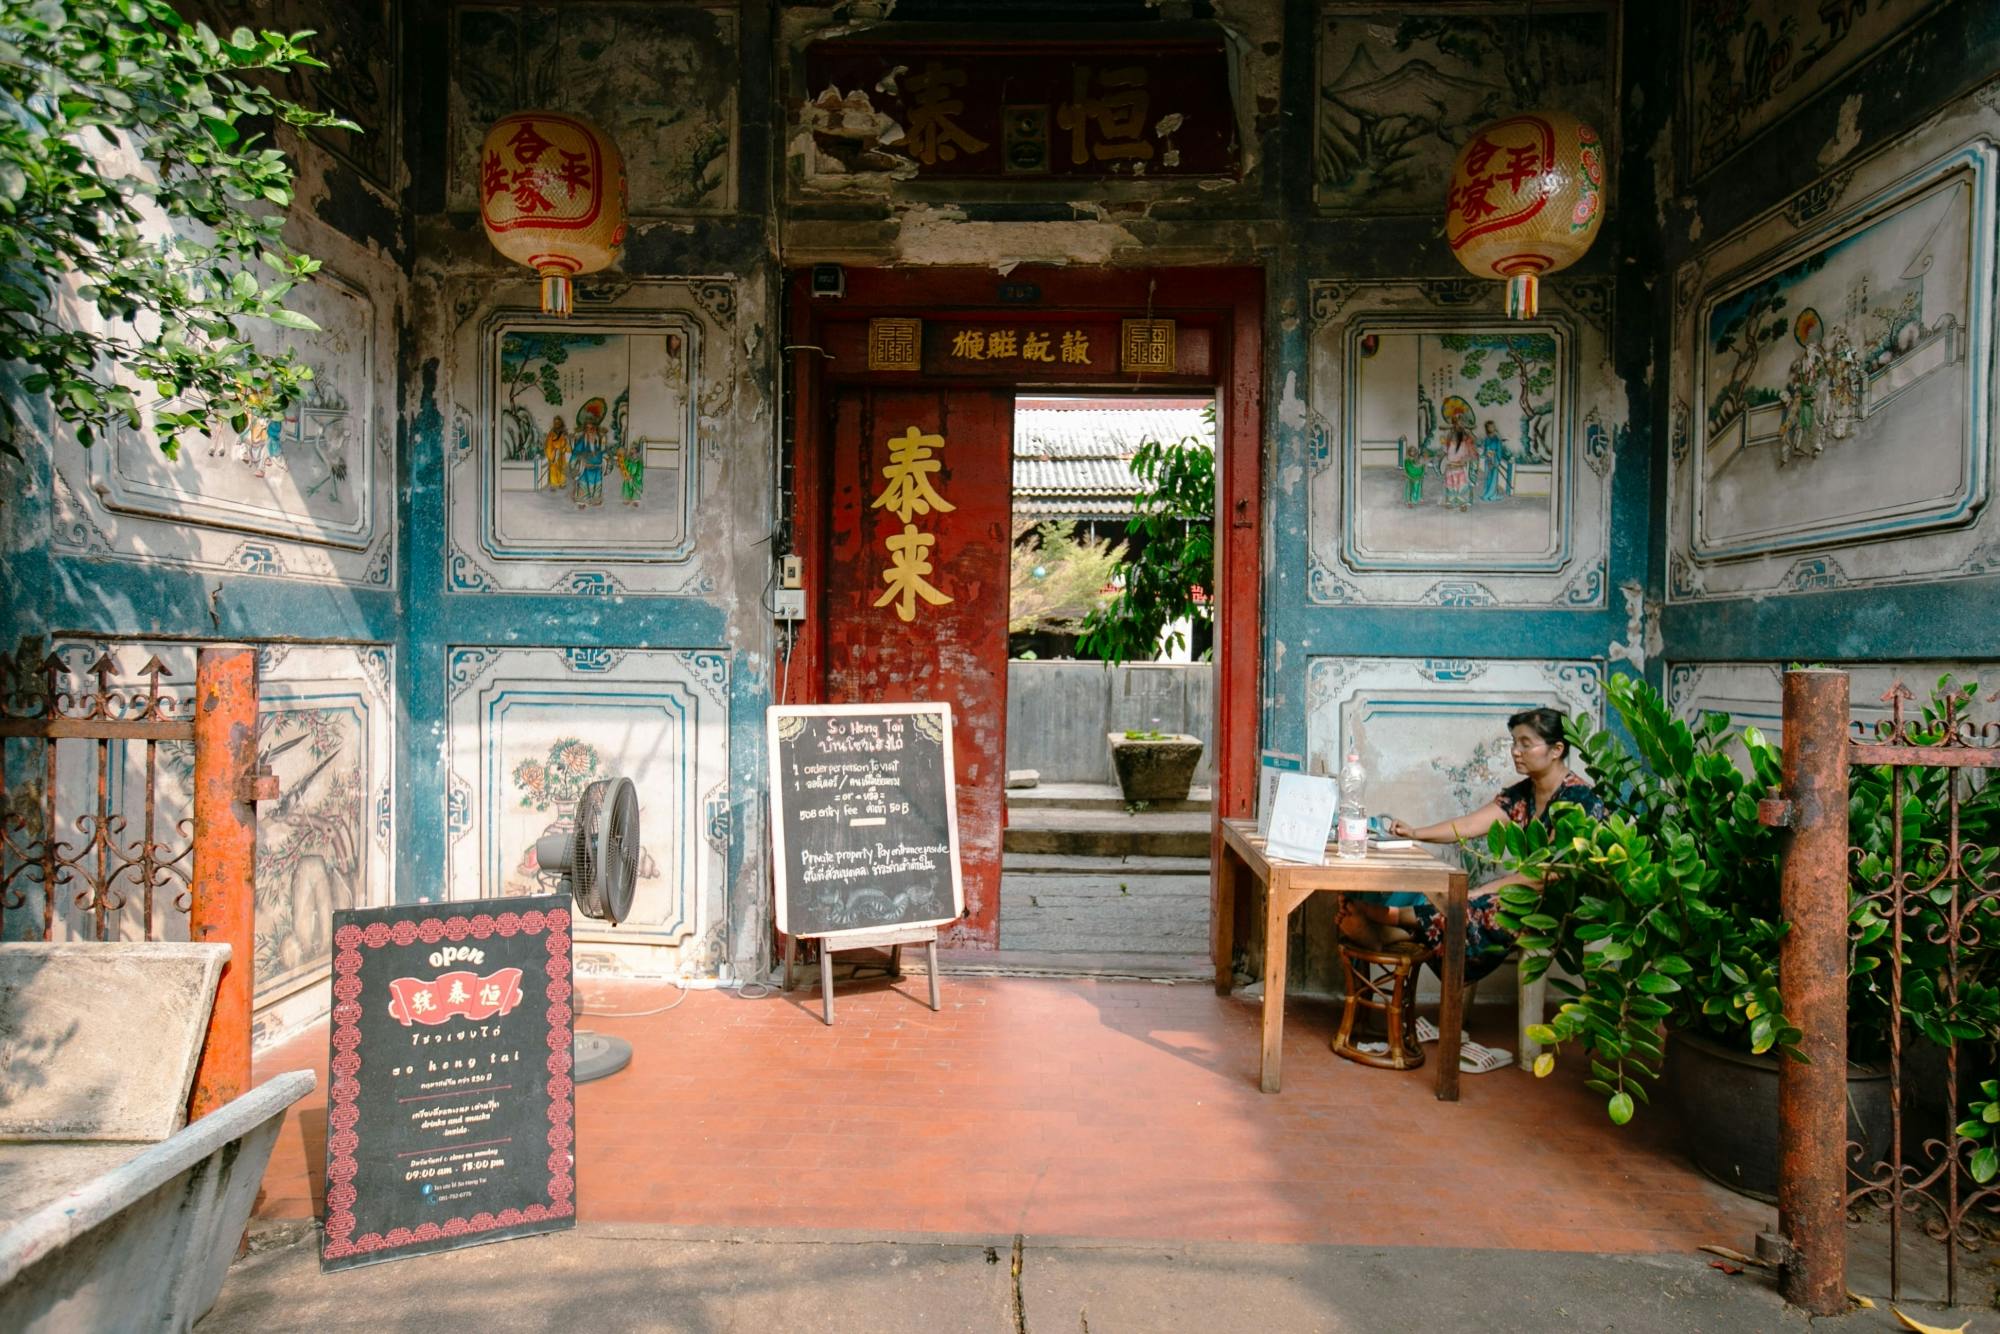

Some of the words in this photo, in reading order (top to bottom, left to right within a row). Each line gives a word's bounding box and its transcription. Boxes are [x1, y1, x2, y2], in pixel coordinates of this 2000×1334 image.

[827, 718, 846, 735] So
[804, 763, 827, 775] order
[818, 804, 840, 823] entry
[801, 849, 834, 865] Private
[836, 847, 873, 864] property
[875, 843, 890, 864] Pay
[429, 945, 485, 967] open
[421, 1118, 446, 1129] drinks
[447, 1115, 463, 1126] and
[465, 1112, 491, 1124] snacks
[437, 1167, 452, 1177] am
[490, 1159, 505, 1169] pm
